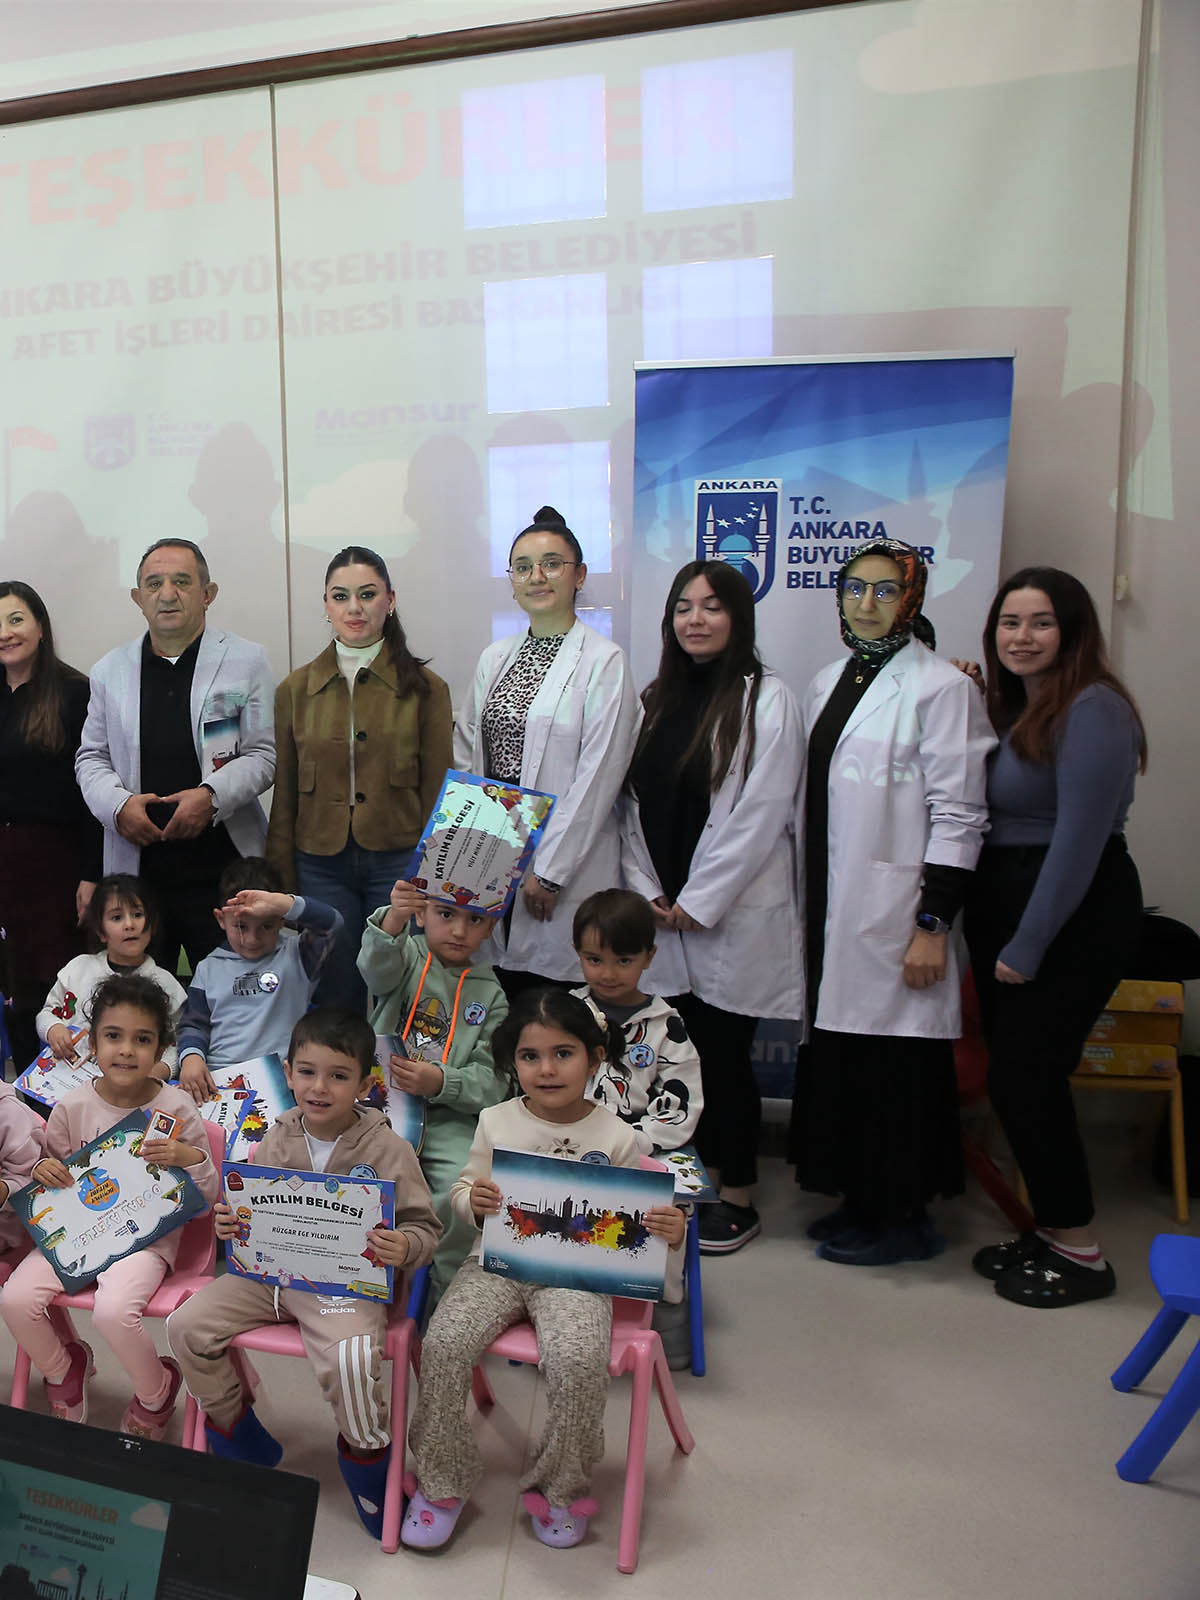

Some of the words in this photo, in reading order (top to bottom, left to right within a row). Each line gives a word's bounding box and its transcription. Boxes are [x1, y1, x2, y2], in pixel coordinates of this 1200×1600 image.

[146, 239, 449, 305] BÜYÜKŞEHİR
[464, 210, 760, 278] BELEDİYESİ
[12, 327, 102, 361] AFET
[113, 309, 230, 358] İŞLERİ
[242, 293, 404, 342] DAİRESİ
[313, 401, 480, 429] Mansur
[697, 480, 778, 491] ANKARA
[789, 496, 831, 515] T.C.
[788, 521, 888, 539] ANKARA
[786, 571, 839, 589] BELE
[250, 1194, 303, 1206] KATILIM
[305, 1197, 364, 1219] BELGESİ
[320, 1306, 356, 1315] adidas
